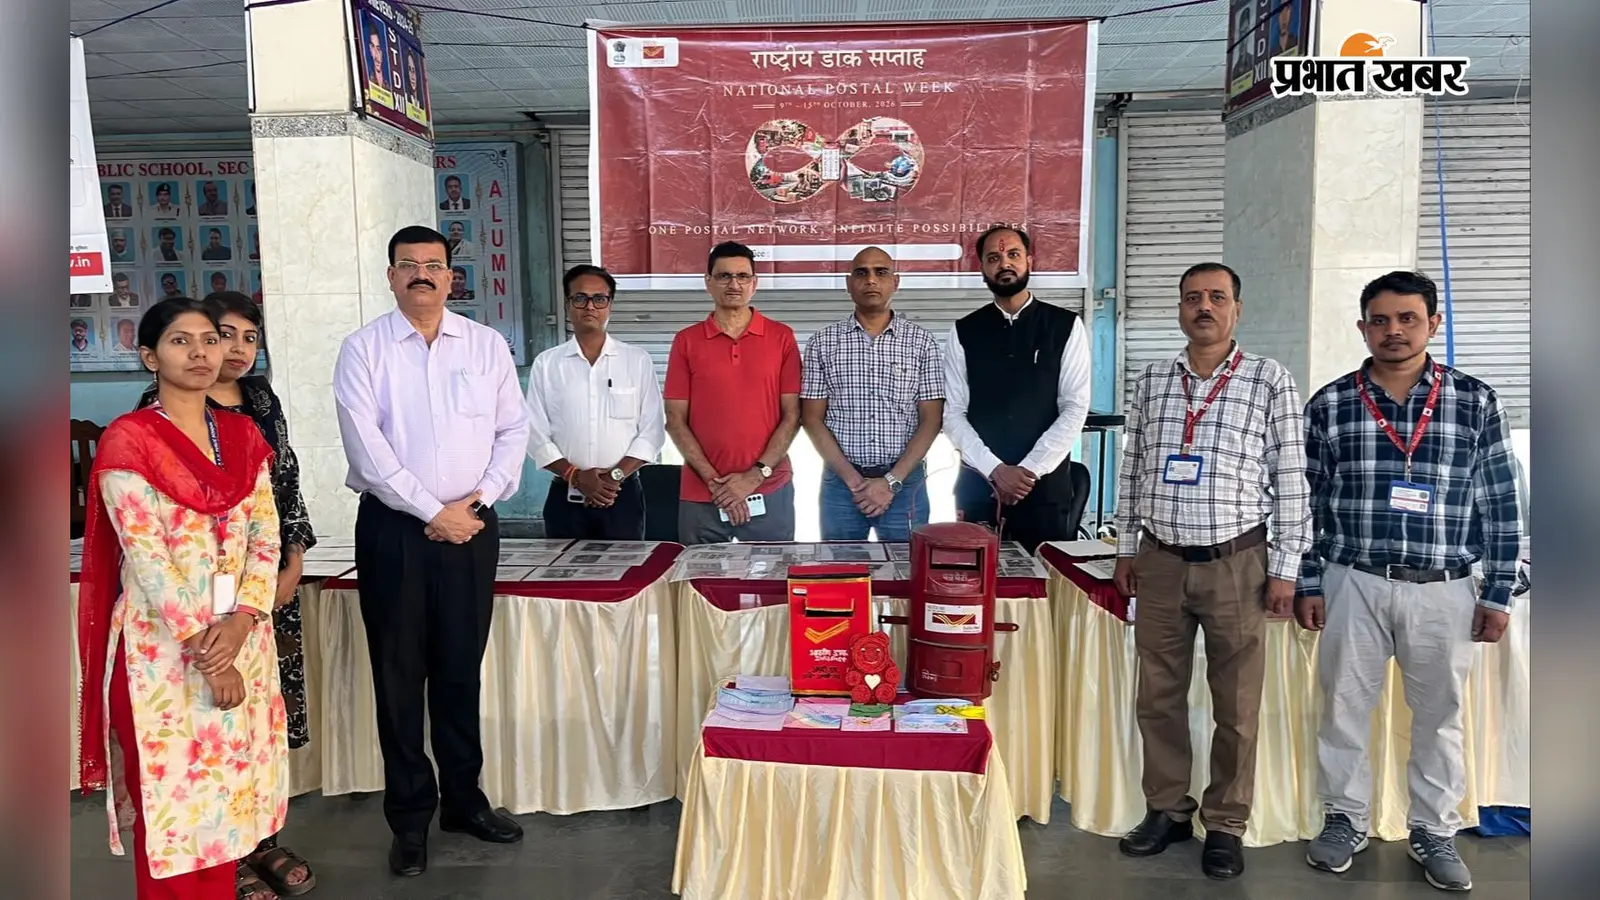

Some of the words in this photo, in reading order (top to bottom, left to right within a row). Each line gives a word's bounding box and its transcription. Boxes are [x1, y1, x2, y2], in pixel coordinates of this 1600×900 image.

[750, 44, 814, 71] राष्ट्रीय
[818, 50, 863, 68] डाक
[866, 49, 927, 69] सप्ताह
[723, 84, 816, 97] NATIONAL
[825, 83, 894, 95] POSTAL
[903, 82, 955, 93] WEEK
[138, 162, 213, 177] SCHOOL,
[217, 161, 248, 175] SEC
[649, 225, 677, 235] ONE
[685, 225, 739, 235] POSTAL
[747, 224, 825, 235] NETWORK,
[833, 223, 904, 233] INFINITE
[489, 179, 506, 320] ALUMNI
